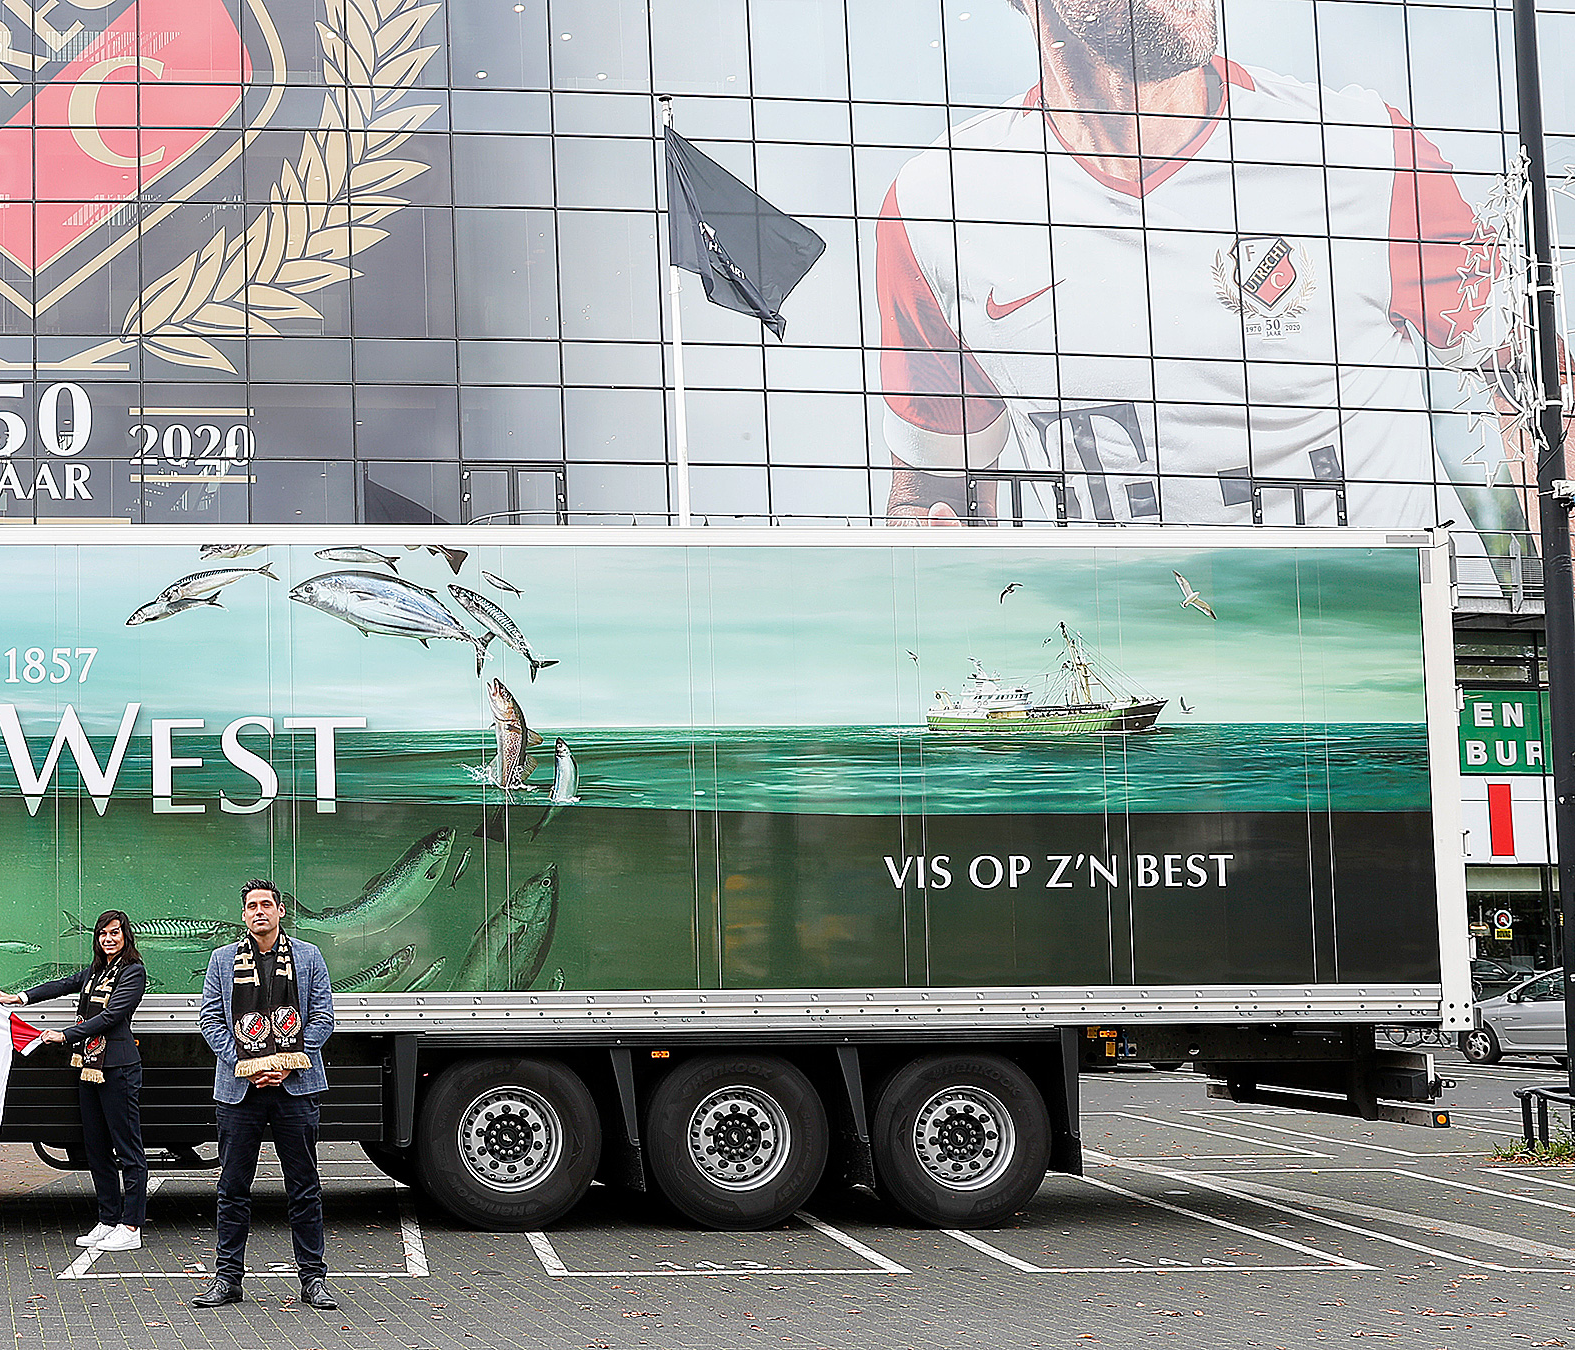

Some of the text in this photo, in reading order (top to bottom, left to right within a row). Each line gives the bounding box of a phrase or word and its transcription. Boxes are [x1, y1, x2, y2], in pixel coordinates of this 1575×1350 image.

[67, 55, 166, 168] C
[1243, 242, 1289, 294] UTRECHT
[1270, 272, 1286, 289] C
[1265, 319, 1281, 331] 50
[127, 423, 257, 467] 2020
[2, 646, 99, 686] 1857
[884, 853, 1235, 889] VIS OP Z'N BEST
